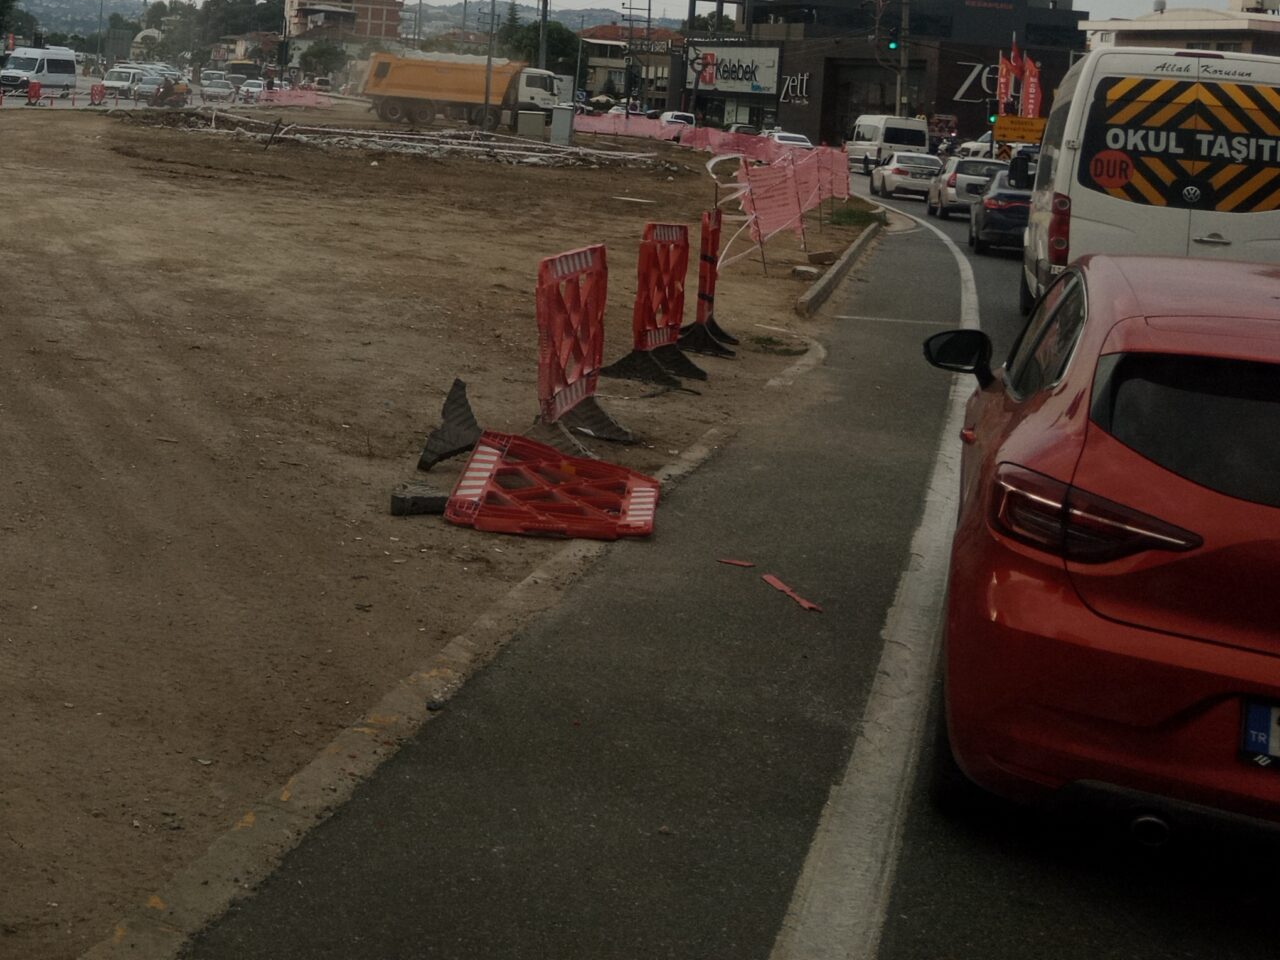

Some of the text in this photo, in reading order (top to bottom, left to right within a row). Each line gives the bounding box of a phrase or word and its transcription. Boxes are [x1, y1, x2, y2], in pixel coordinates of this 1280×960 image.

[715, 58, 760, 81] Kelebek
[1153, 62, 1253, 77] Allah Korusun
[1105, 127, 1184, 154] OKUL
[1094, 157, 1129, 179] DUR
[1250, 730, 1268, 744] TR
